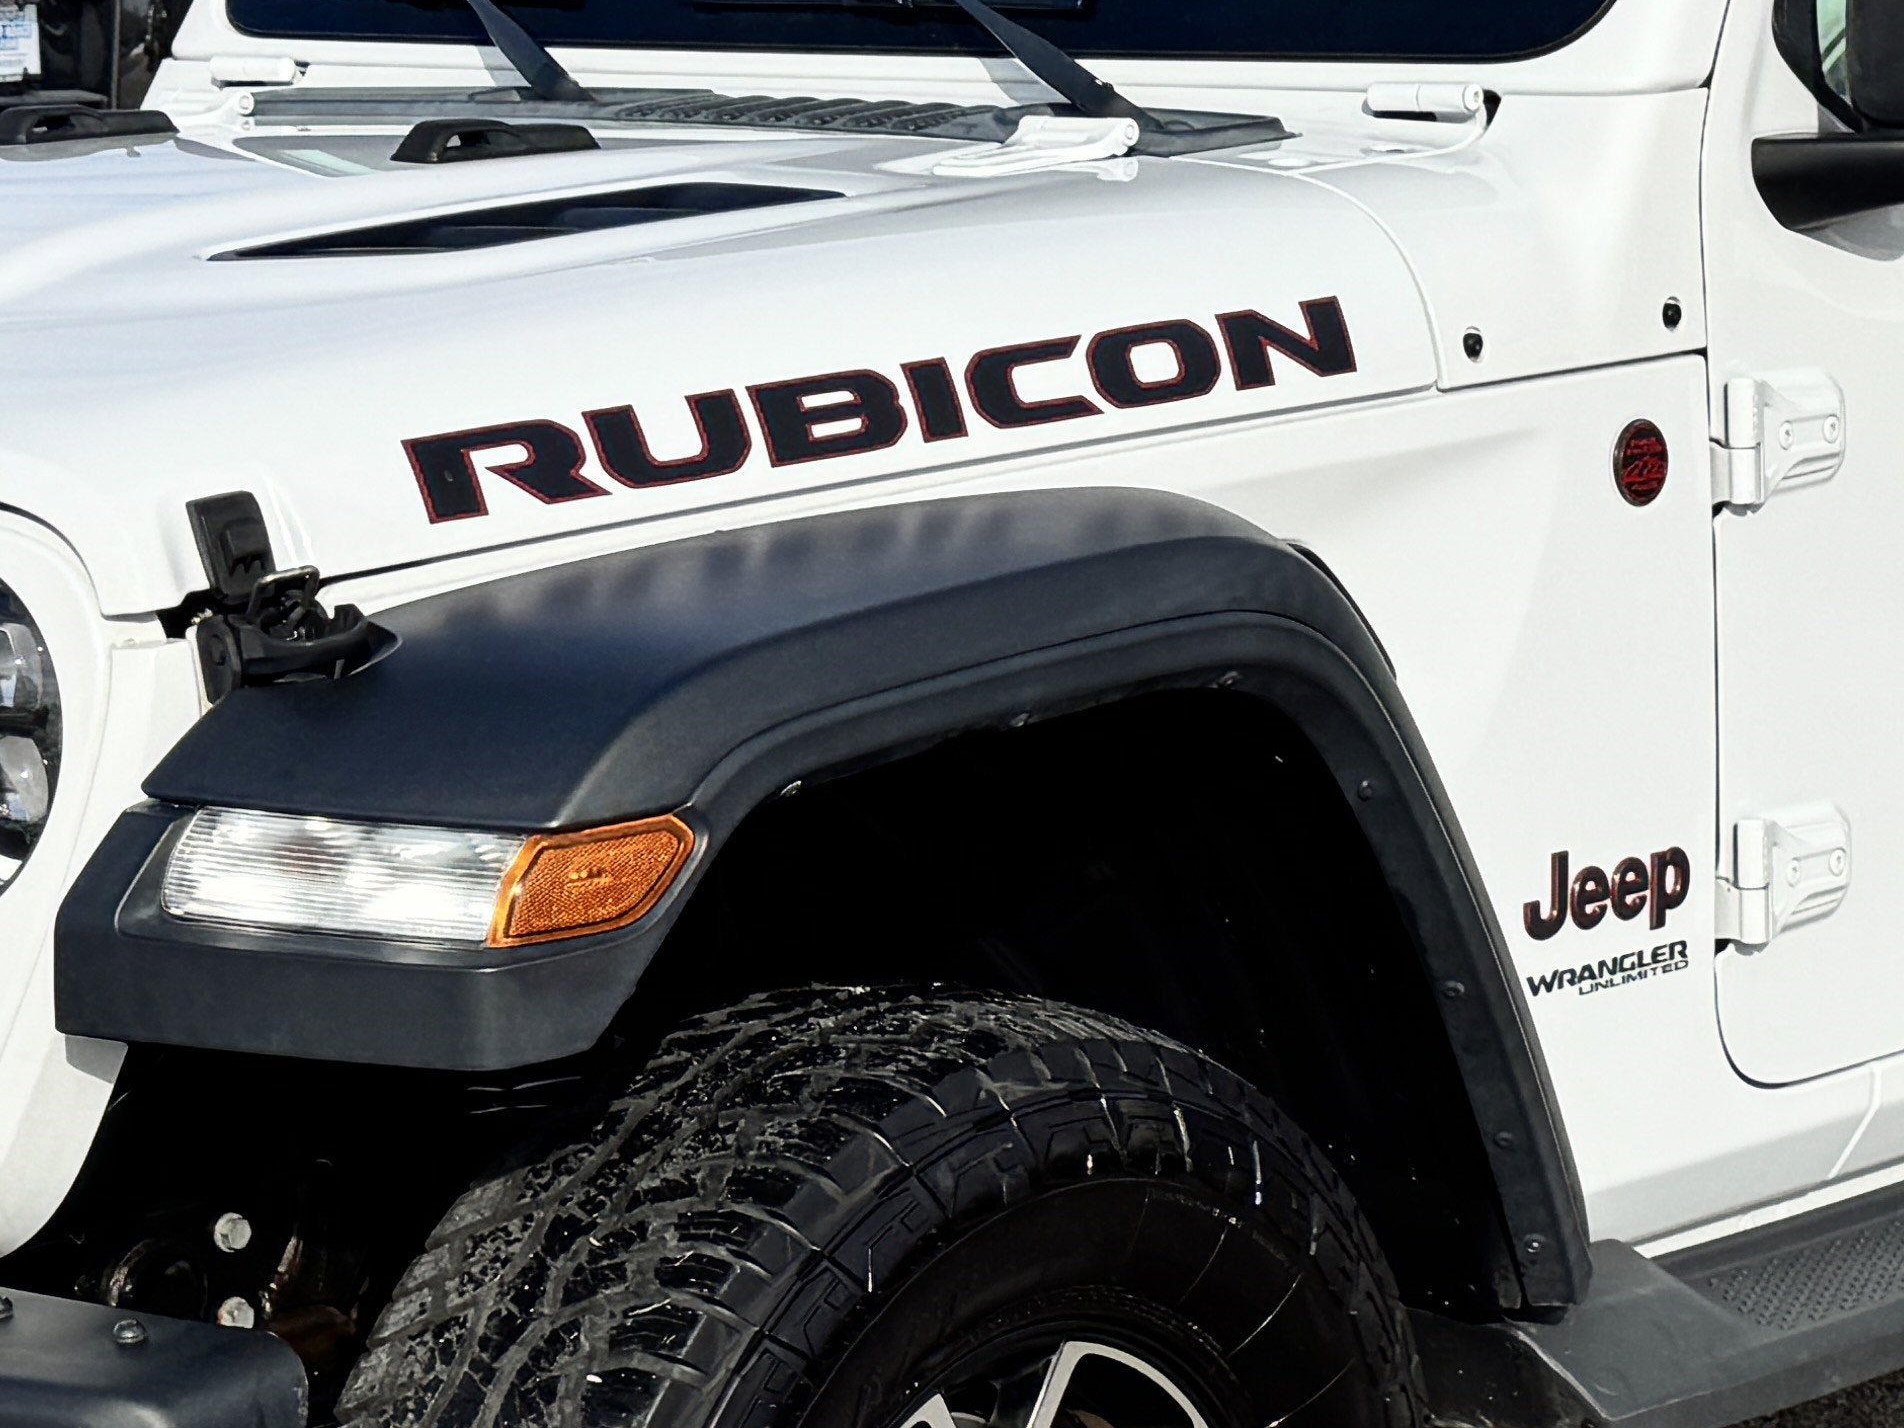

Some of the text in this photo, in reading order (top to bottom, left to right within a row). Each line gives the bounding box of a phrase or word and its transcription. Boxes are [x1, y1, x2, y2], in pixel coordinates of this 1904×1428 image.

[400, 294, 1358, 525] RUBICON
[1523, 846, 1691, 941] Jeep
[1526, 940, 1689, 997] WRANGLER
[1578, 959, 1689, 996] UNLIMITED
